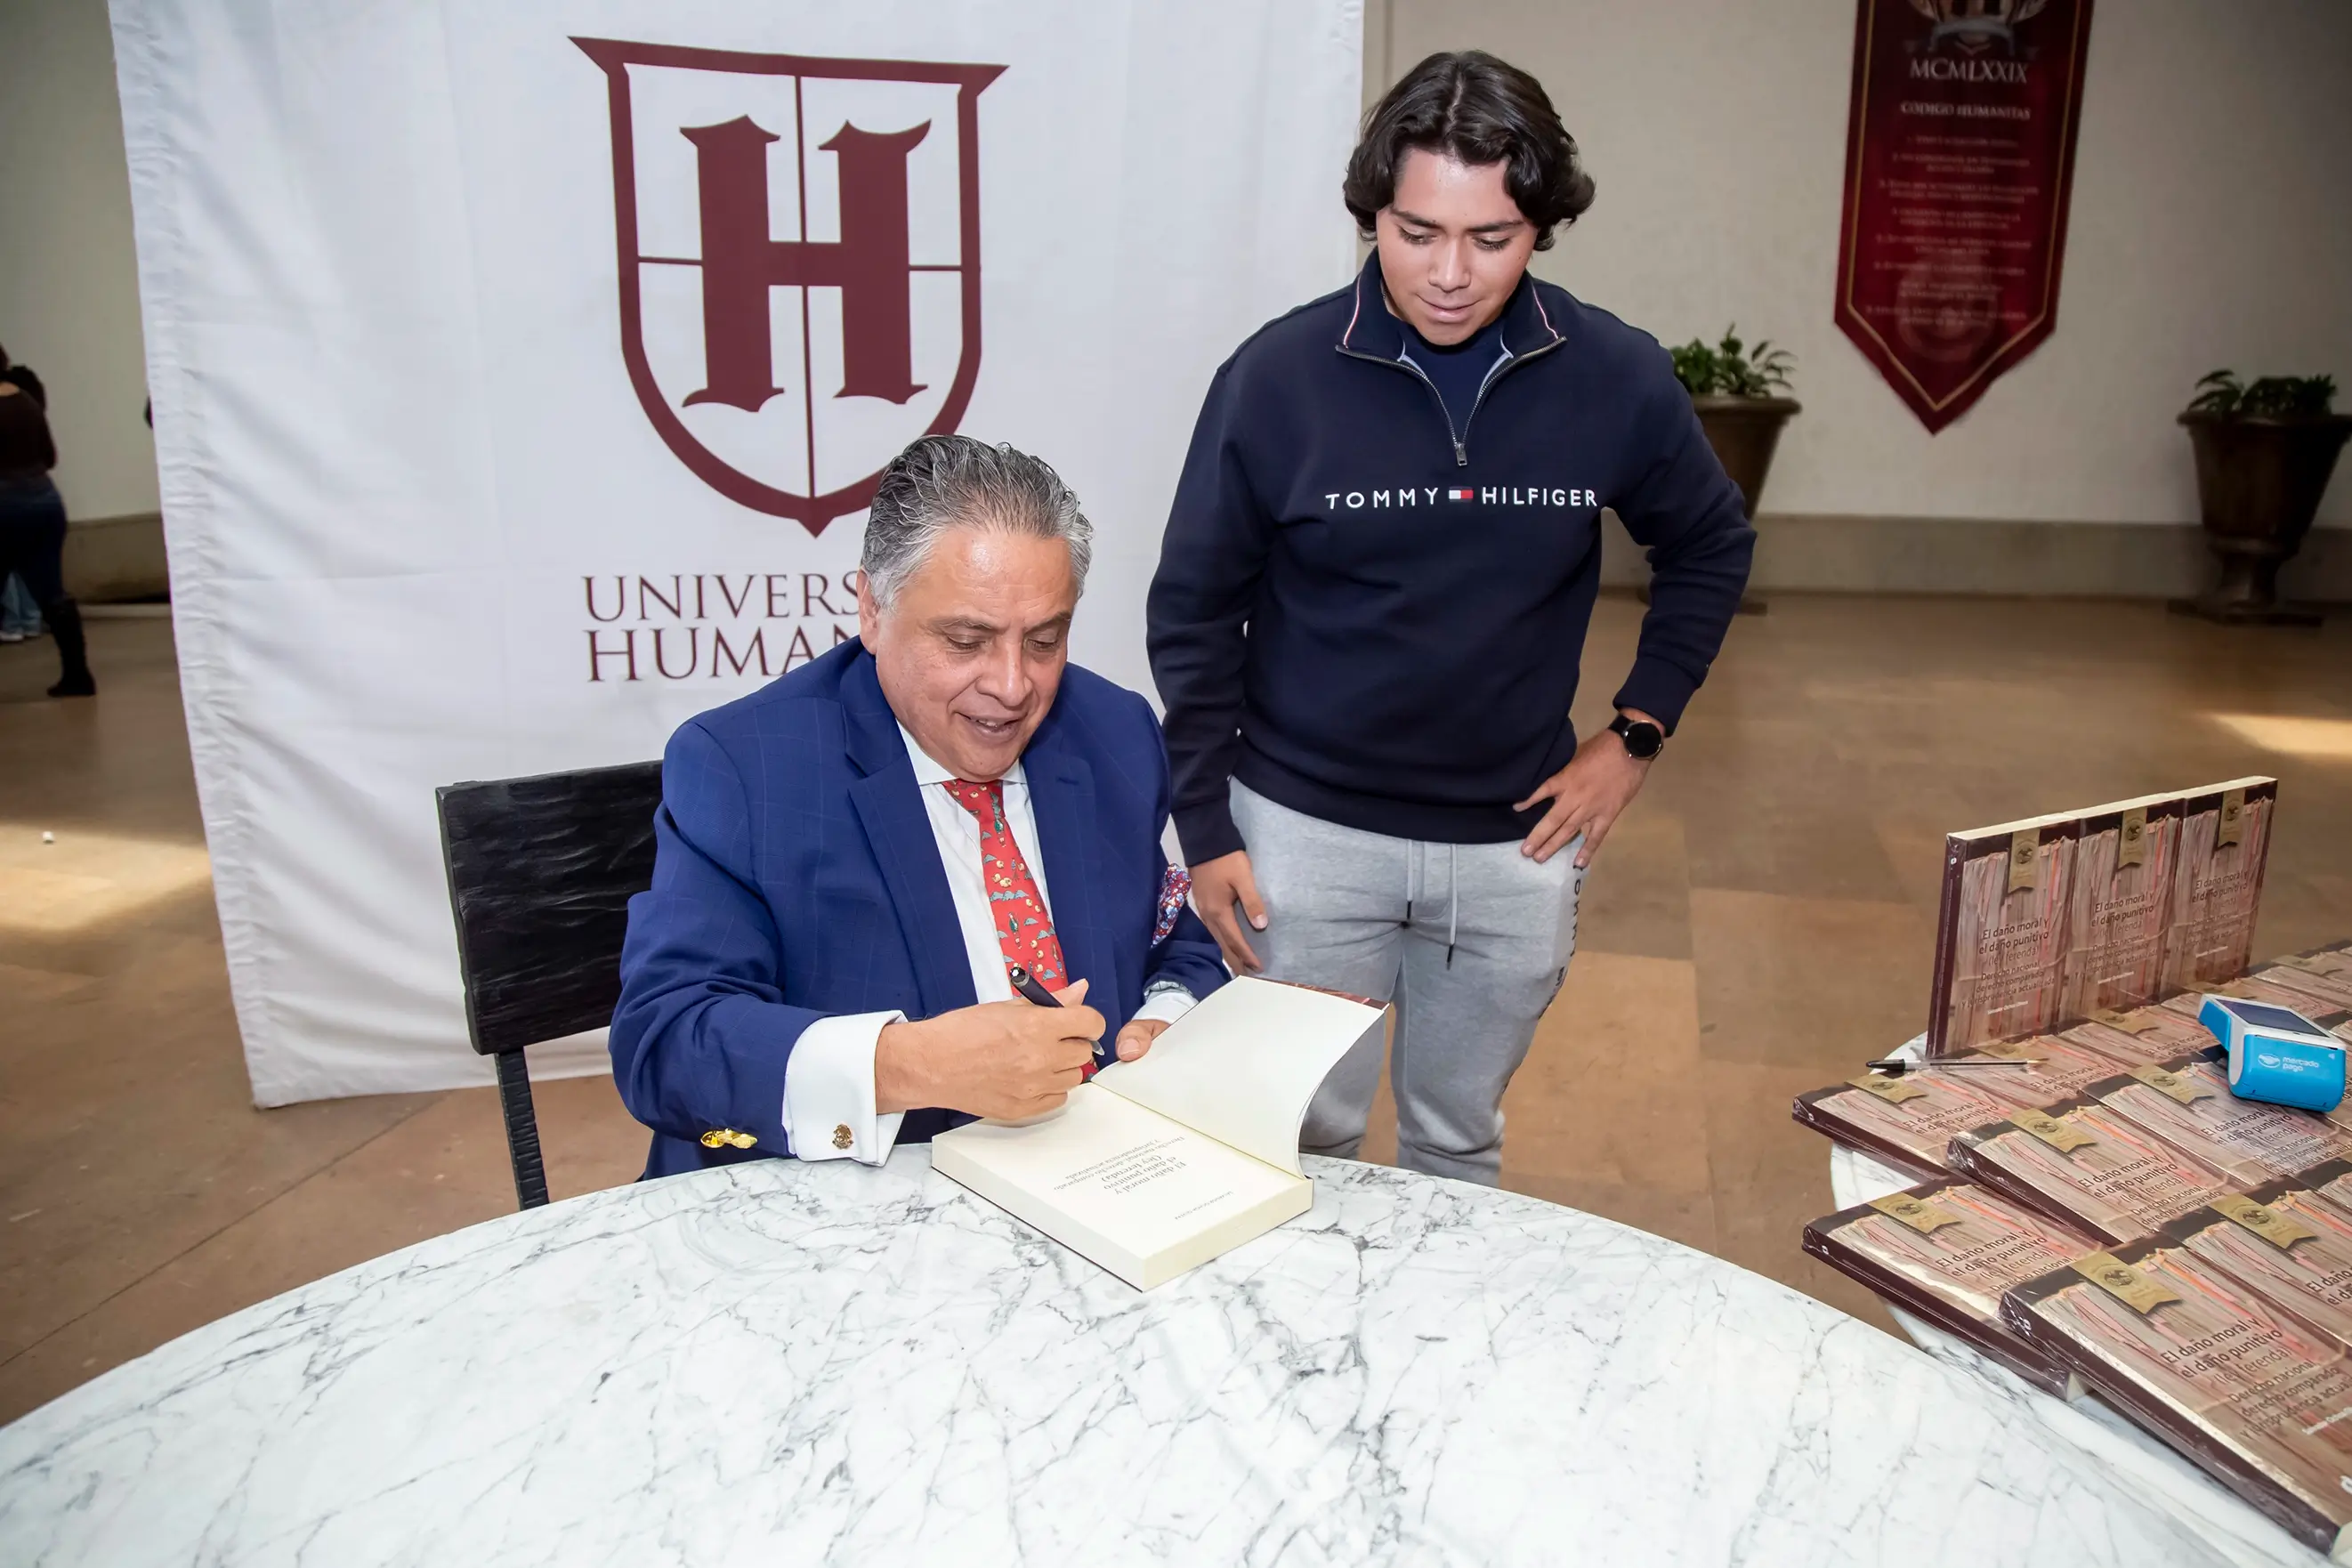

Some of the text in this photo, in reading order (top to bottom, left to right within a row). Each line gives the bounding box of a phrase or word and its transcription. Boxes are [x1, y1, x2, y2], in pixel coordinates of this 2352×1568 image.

[1910, 57, 2027, 84] MCMLXXIX
[1957, 104, 2032, 120] HUMANITAS
[679, 114, 932, 412] H
[1325, 486, 1597, 510] TOMMY HILFIGER
[581, 570, 860, 622] UNIVERS
[583, 624, 853, 683] HUMA
[2095, 903, 2102, 912] El
[2105, 898, 2123, 910] daño
[2126, 891, 2147, 905] moral
[2091, 905, 2154, 926] el daño punitivo
[1983, 917, 2049, 940] El daño moral y
[1979, 931, 2049, 954] el daño punitivo
[1982, 969, 2009, 980] Derecho
[2283, 1056, 2319, 1068] mercado
[2283, 1063, 2303, 1072] pago
[1903, 1119, 1917, 1128] El
[1918, 1113, 1944, 1123] daño
[1945, 1102, 1976, 1115] moral
[1928, 1119, 1954, 1129] daño
[1955, 1106, 1999, 1122] punitivo
[2215, 1120, 2239, 1132] daño
[2239, 1109, 2269, 1124] moral
[2217, 1115, 2291, 1144] el daño punitivo
[1105, 1141, 1154, 1163] jurisprudencia
[1155, 1136, 1184, 1151] Derecho
[2254, 1147, 2288, 1160] Derecho
[1065, 1161, 1105, 1180] actualizada
[1095, 1160, 1124, 1176] derecho
[1101, 1155, 1162, 1183] (ley ferenda)
[1103, 1156, 1176, 1190] el daño punitivo
[1152, 1167, 1174, 1179] daño
[1175, 1161, 1186, 1169] El
[2078, 1155, 2163, 1188] El daño moral y
[2265, 1154, 2295, 1169] derecho
[1054, 1174, 1095, 1191] comparado
[1122, 1175, 1151, 1192] moral
[2094, 1164, 2178, 1200] el daño punitivo
[2119, 1176, 2186, 1203] (ley ferenda)
[2131, 1199, 2170, 1216] Derecho
[2142, 1208, 2177, 1225] derecho
[1936, 1258, 1952, 1267] El
[1952, 1249, 1984, 1262] daño
[1984, 1233, 2019, 1250] moral
[1952, 1237, 2047, 1277] el daño punitivo
[1979, 1250, 2054, 1280] (ley ferenda)
[1990, 1273, 2033, 1291] Derecho
[2306, 1281, 2325, 1292] El
[2327, 1294, 2342, 1305] el
[2161, 1318, 2264, 1364] El daño moral y
[2181, 1330, 2283, 1378] el daño punitivo
[2213, 1347, 2293, 1385] (ley ferenda)
[2228, 1381, 2273, 1403] Derecho
[2242, 1367, 2340, 1418] derecho comparado
[2239, 1431, 2251, 1440] y
[2249, 1394, 2323, 1436] jurisprudencia
